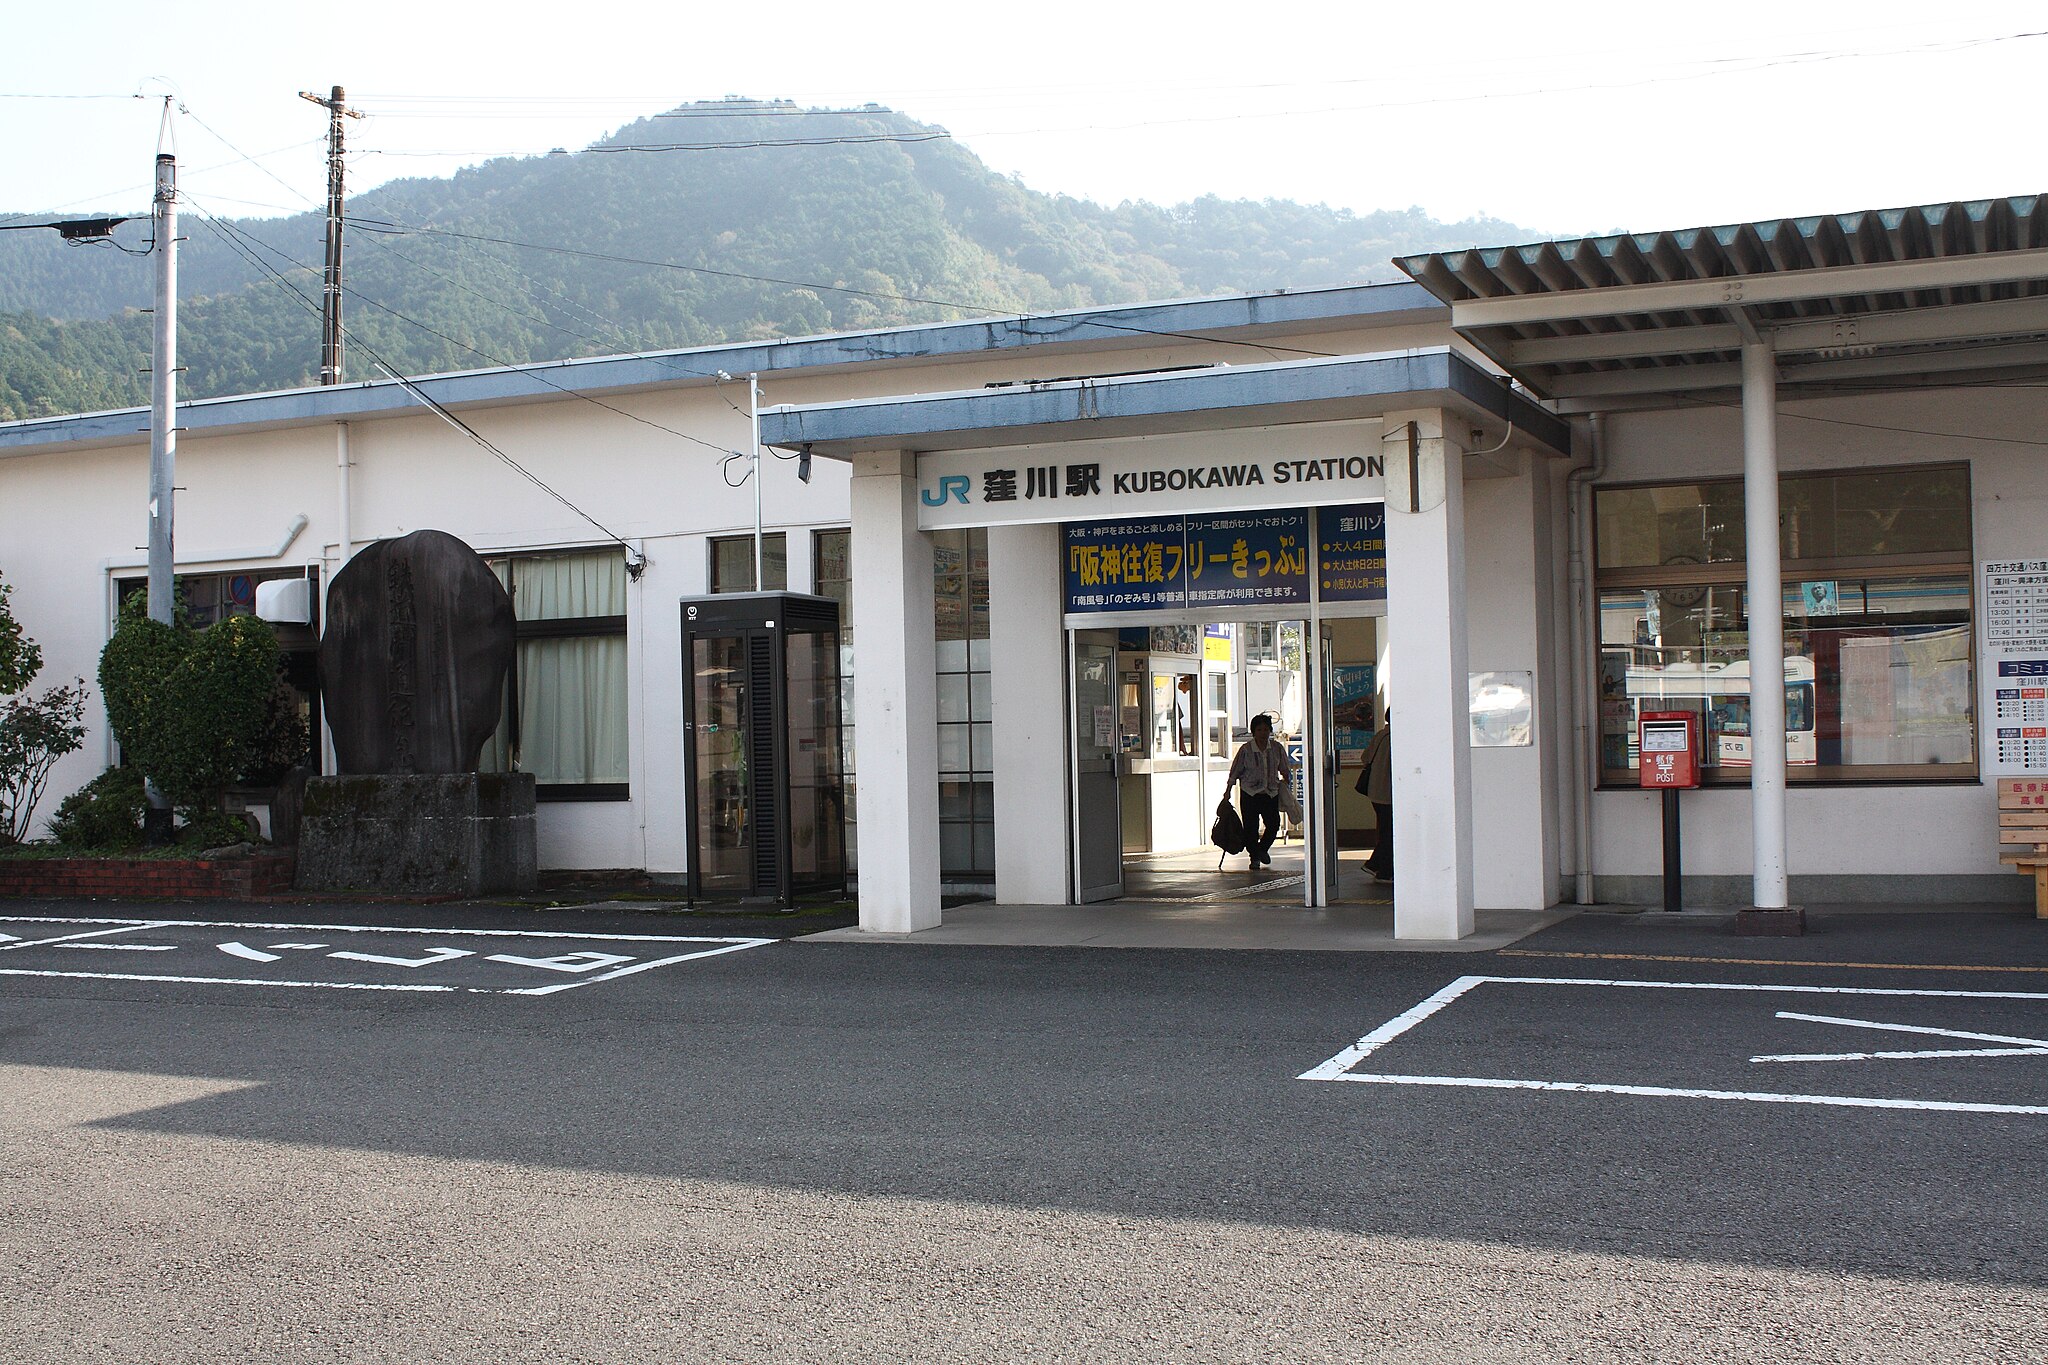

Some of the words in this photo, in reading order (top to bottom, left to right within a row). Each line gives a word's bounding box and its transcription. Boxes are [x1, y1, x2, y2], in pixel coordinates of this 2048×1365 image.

[984, 463, 1100, 502] 窪川駅
[1113, 464, 1264, 494] KUBOKAWA
[1273, 455, 1384, 485] STATION
[922, 475, 970, 506] JR
[1340, 514, 1385, 532] 窪川ゾ
[2007, 663, 2048, 674] コミュ
[1656, 754, 1674, 765] 郵便
[1656, 773, 1675, 783] POST
